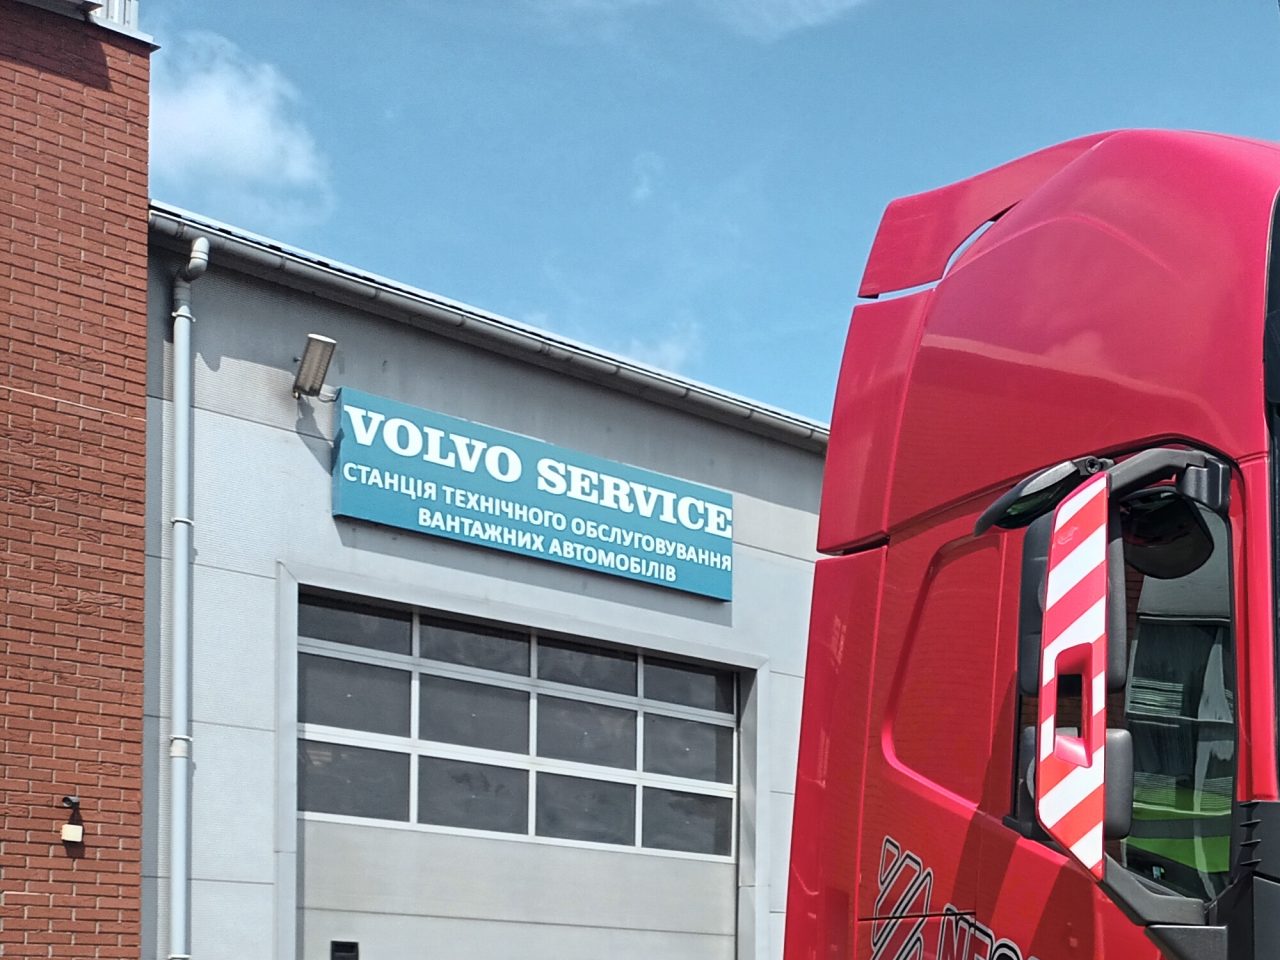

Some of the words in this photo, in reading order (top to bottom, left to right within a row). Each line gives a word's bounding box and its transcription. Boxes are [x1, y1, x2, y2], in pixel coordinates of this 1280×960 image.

[342, 462, 437, 501] СТАНЦІЯ
[442, 485, 567, 531] ТЕХНІЧНОГО
[571, 517, 732, 571] ОБСЛУГОВУВАННЯ
[344, 405, 522, 483] VOLVO
[537, 457, 732, 538] SERVICE
[418, 508, 545, 553] ВАНТАЖНИХ
[549, 538, 677, 583] АВТОМОБІЛІВ
